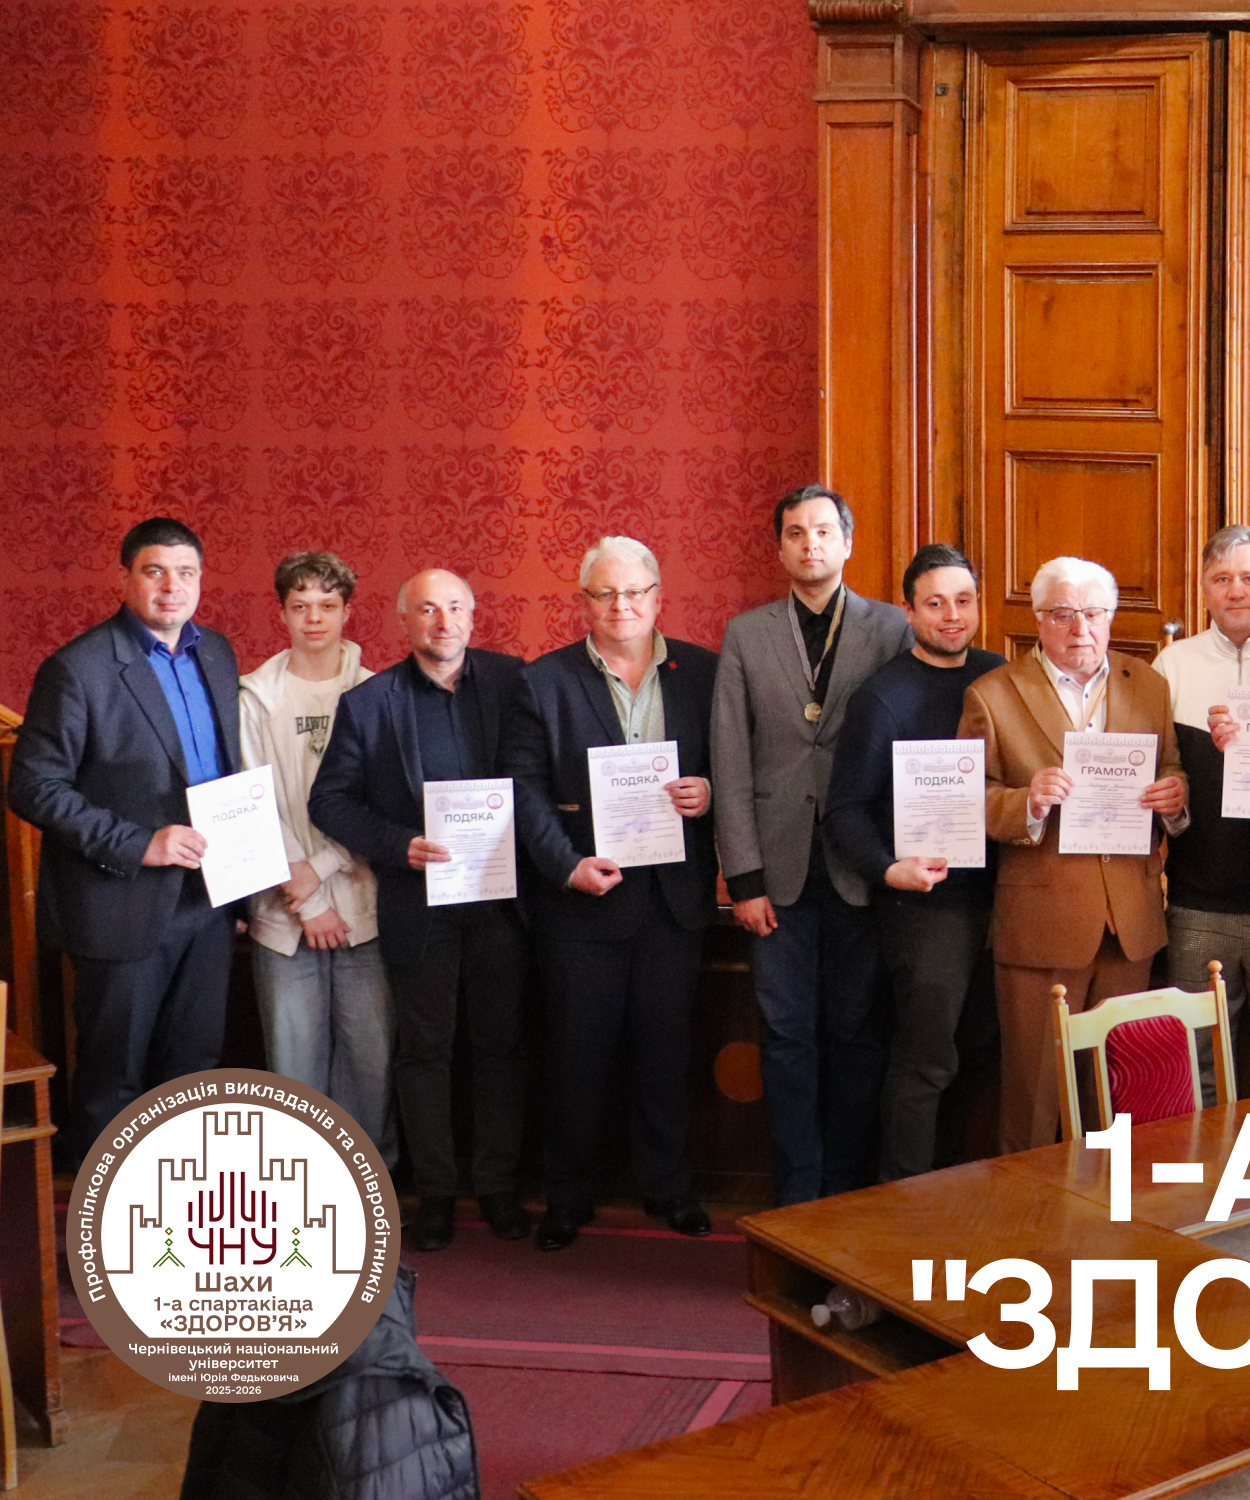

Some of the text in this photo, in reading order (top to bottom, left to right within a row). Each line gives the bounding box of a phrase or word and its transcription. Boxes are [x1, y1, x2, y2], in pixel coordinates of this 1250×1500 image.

[1081, 766, 1137, 777] ГРАМОТА
[611, 774, 660, 787] ПОДЯКА
[914, 776, 965, 787] ПОДЯКА
[212, 803, 258, 824] ПОДЯКА
[444, 812, 495, 824] ПОДЯКА
